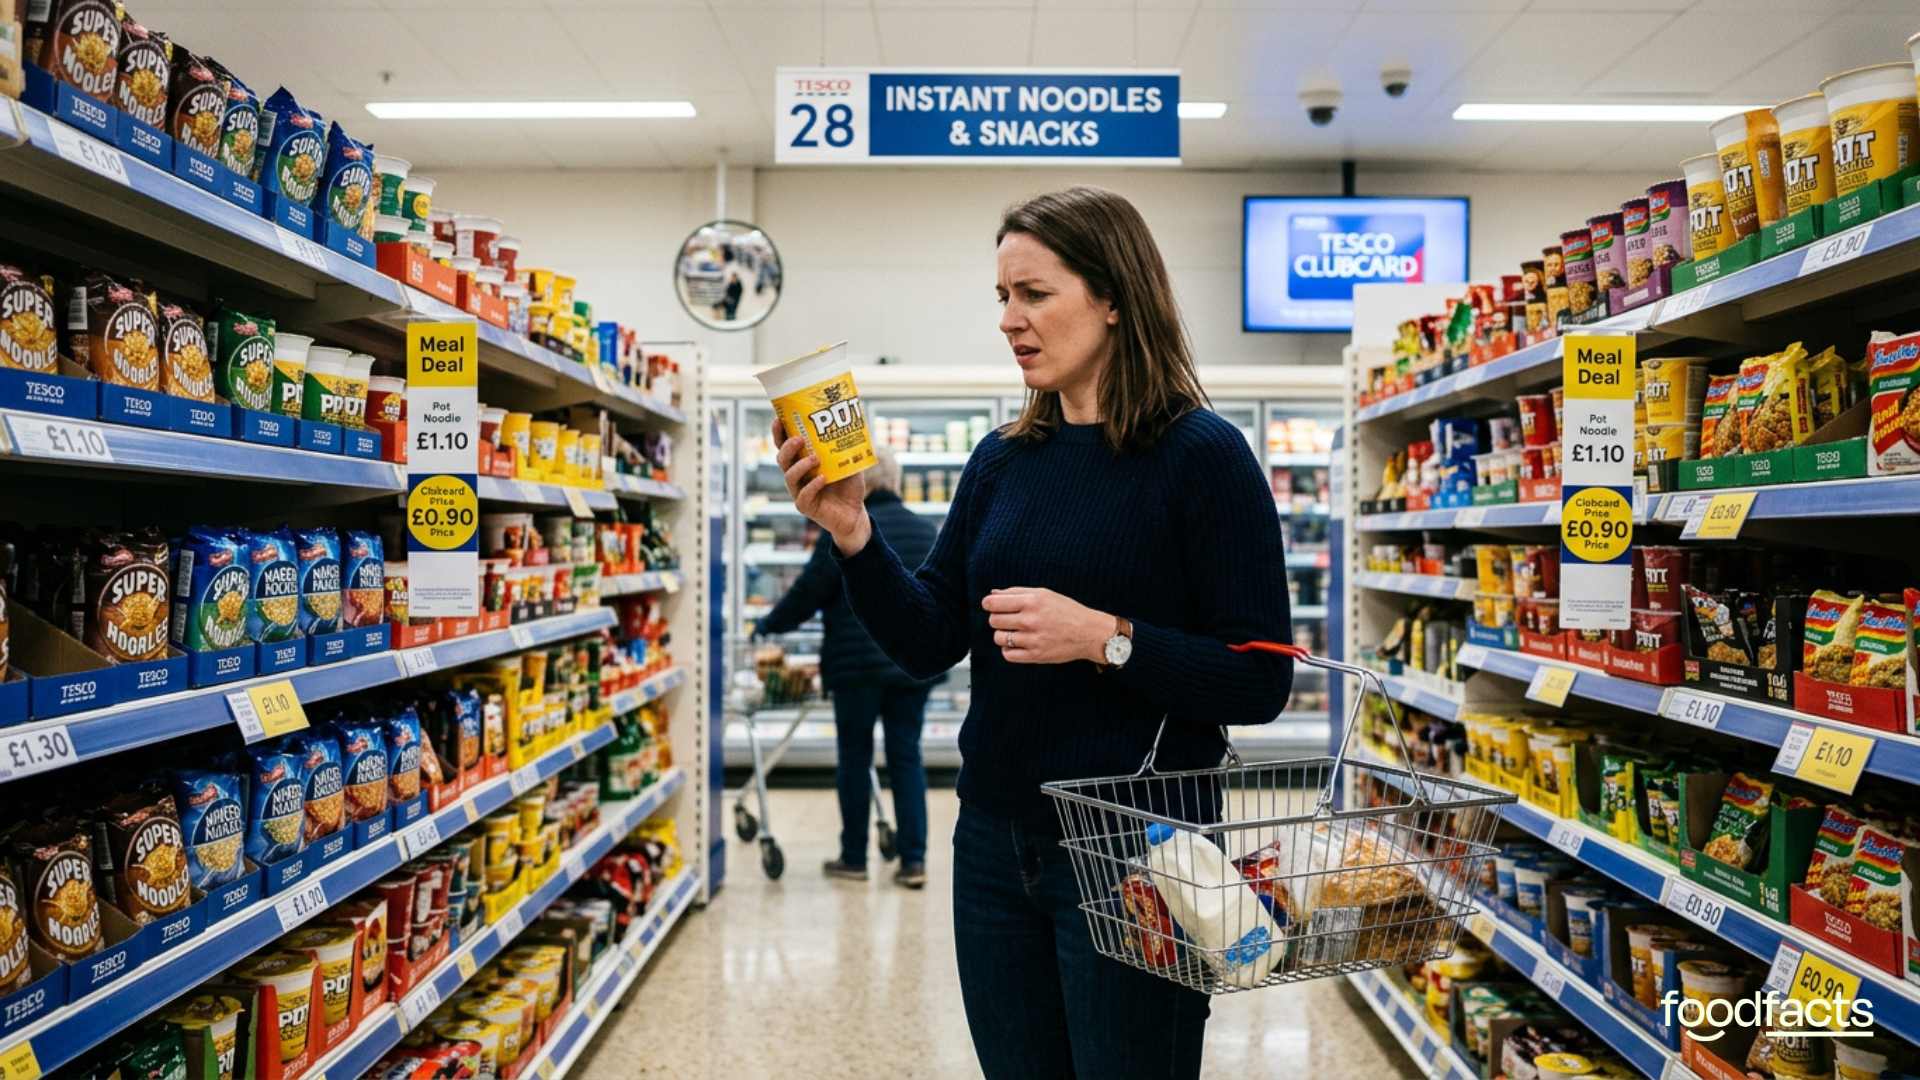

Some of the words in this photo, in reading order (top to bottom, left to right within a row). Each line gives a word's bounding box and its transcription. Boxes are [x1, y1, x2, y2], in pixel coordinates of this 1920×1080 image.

[885, 85, 1011, 112] INSTANT
[1018, 86, 1164, 113] NOODLES
[790, 103, 854, 147] 28
[948, 120, 971, 146] &
[979, 121, 1100, 147] SNACKS
[1318, 232, 1396, 256] TESCO
[1293, 254, 1419, 279] CLUBCARD
[420, 335, 464, 352] Meal
[422, 356, 463, 372] Deal
[1577, 348, 1622, 365] Meal
[1578, 368, 1620, 385] Deal
[432, 402, 451, 411] Pot
[1589, 414, 1607, 424] Pot
[46, 423, 105, 455] £1.10
[416, 431, 469, 450] £1.10
[1572, 443, 1625, 463] £1.10
[412, 508, 473, 526] £0.90
[1567, 520, 1628, 539] £0.90
[1584, 540, 1609, 549] Price
[112, 570, 167, 604] SUPER
[8, 732, 69, 768] £1.30
[1814, 741, 1853, 767] £1.10
[1800, 966, 1844, 999] £0.90
